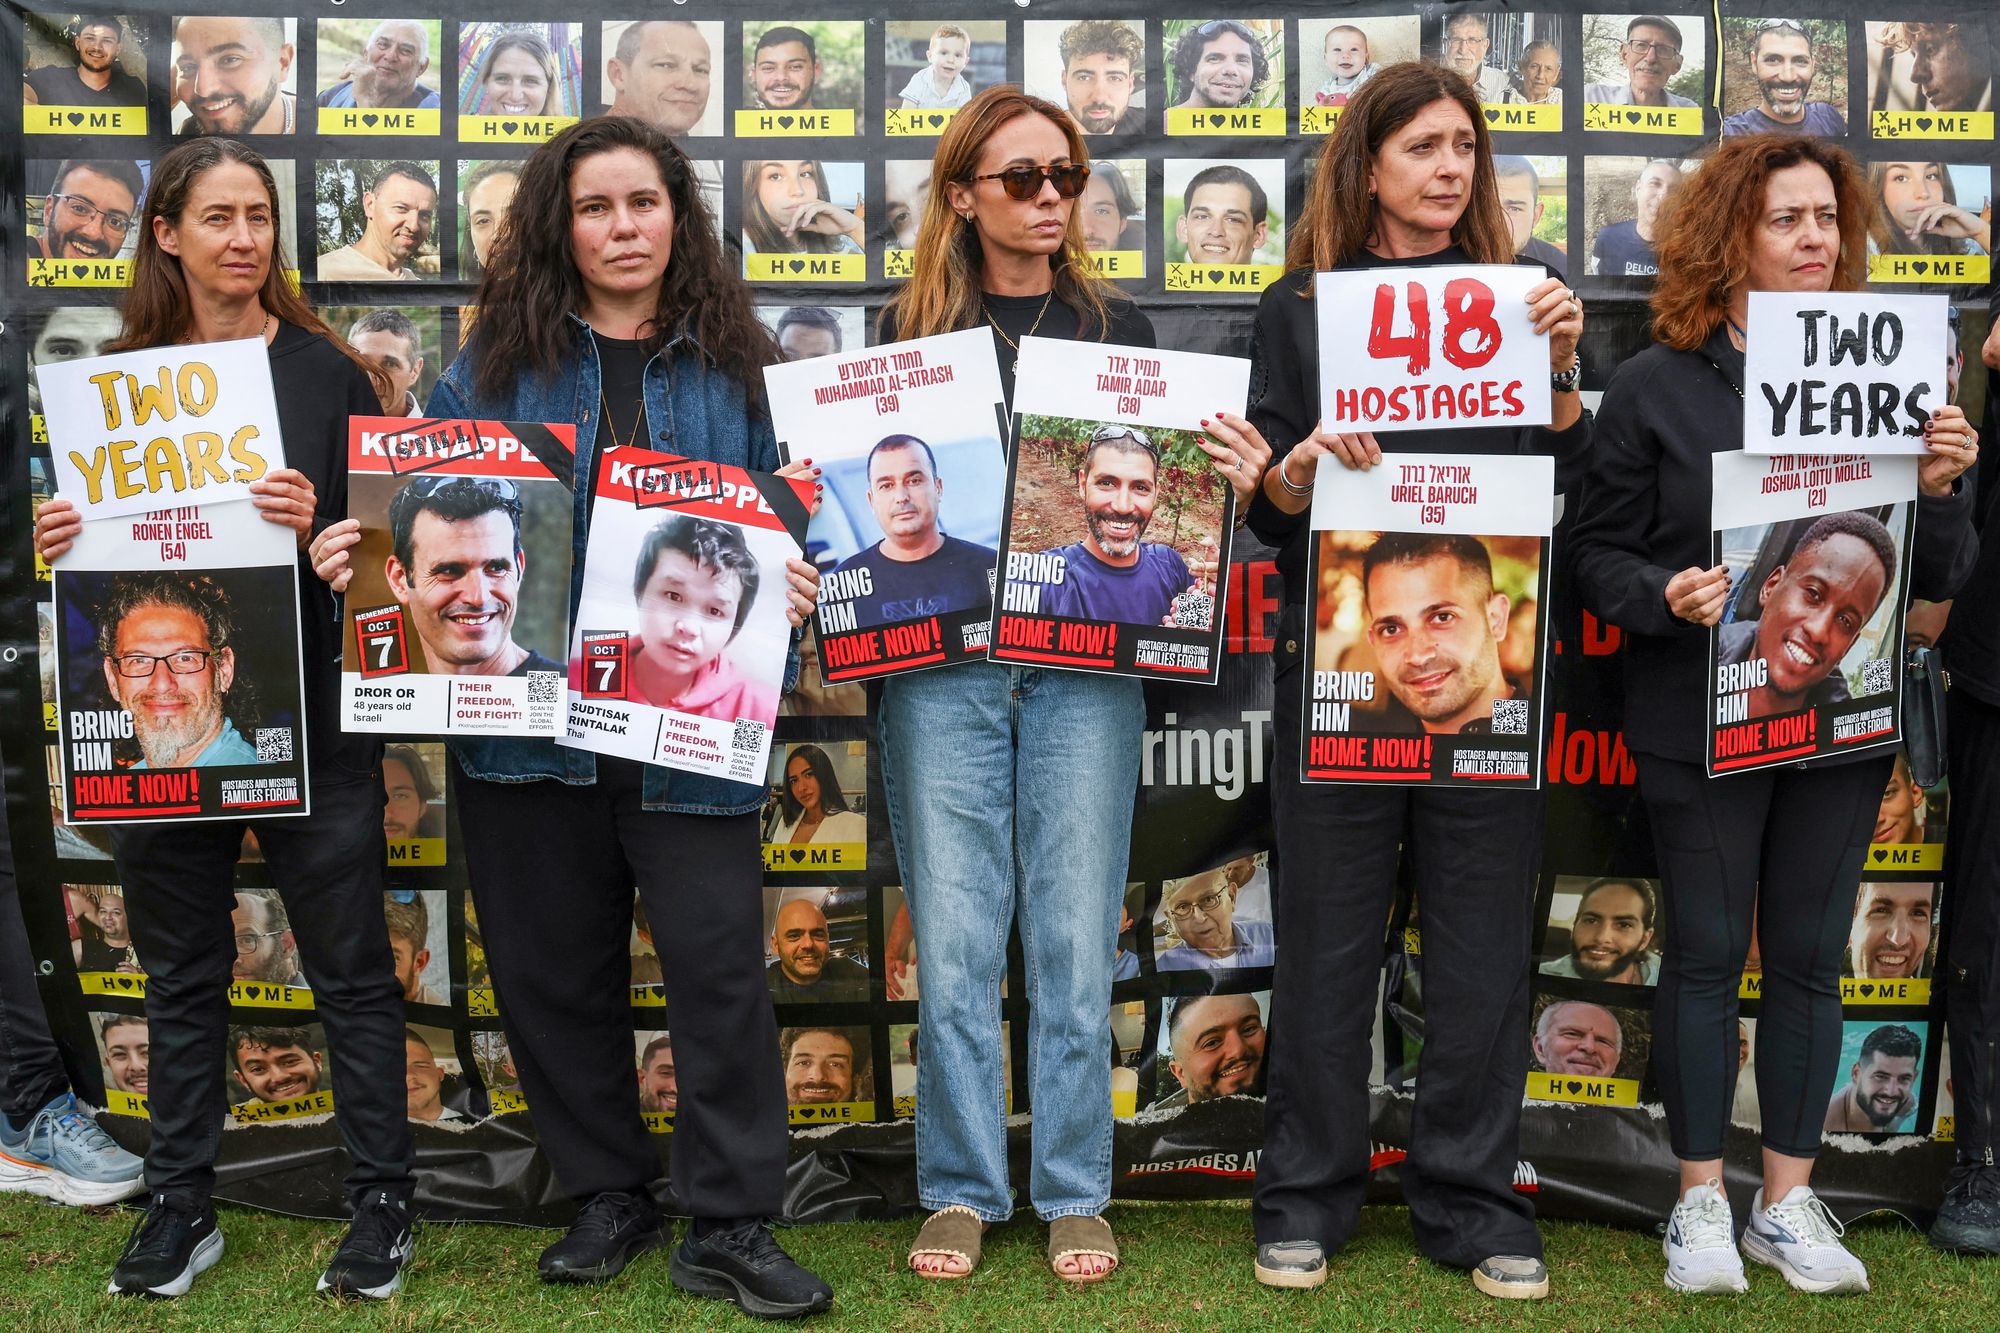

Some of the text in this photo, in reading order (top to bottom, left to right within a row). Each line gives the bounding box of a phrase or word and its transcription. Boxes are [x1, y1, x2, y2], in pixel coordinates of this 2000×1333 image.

[1367, 277, 1503, 376] 48
[1796, 309, 1904, 368] TWO
[1107, 355, 1161, 378] תמיר אדר
[88, 361, 219, 431] TWO
[814, 364, 954, 406] MUHAMMAD AL-ATRASH
[1096, 374, 1167, 398] TAMIR ADAR
[875, 392, 900, 417] (39)
[1117, 394, 1141, 417] (38)
[1335, 380, 1526, 423] HOSTAGES
[1760, 379, 1932, 440] YEARS
[395, 424, 472, 462] STILL
[68, 424, 269, 505] YEARS
[1399, 464, 1471, 485] אוריאל ברוך
[642, 467, 714, 496] STILL
[1760, 461, 1873, 495] JOSHUA LOITU MOLLEL
[1391, 485, 1477, 505] URIEL BARUCH
[1807, 486, 1827, 509] (21)
[1420, 504, 1446, 526] (35)
[132, 522, 213, 541] RONEN ENGEL
[160, 541, 186, 562] (54)
[1005, 551, 1067, 585] BRING
[817, 566, 874, 604] BRING
[1002, 582, 1041, 614] HIM
[355, 604, 401, 621] REMEMBER
[818, 600, 858, 635] HIM
[367, 620, 391, 633] OCT
[583, 631, 627, 643] REMEMBER
[999, 615, 1120, 657] HOME NOW!
[370, 635, 394, 668] 7
[593, 646, 616, 655] OCT
[823, 616, 943, 669] HOME NOW!
[963, 632, 990, 649] FAMIL
[1137, 639, 1210, 656] HOSTAGES AND MISSING
[1135, 650, 1209, 670] FAMILIES FORUM
[594, 660, 616, 691] 7
[1312, 670, 1375, 701] BRING
[1716, 657, 1769, 695] BRING
[354, 687, 416, 699] DROR OR
[457, 683, 493, 693] THEIR
[353, 701, 412, 712] 48 years old
[457, 696, 515, 708] FREEDOM,
[570, 702, 631, 723] SUDTISAK
[1716, 692, 1748, 726] HIM
[70, 709, 134, 741] BRING
[353, 713, 382, 723] Israeli
[456, 710, 523, 720] OUR FIGHT!
[568, 715, 627, 736] RINTALAK
[668, 718, 701, 732] THEIR
[1311, 702, 1350, 732] HIM
[1833, 706, 1893, 727] HOSTAGES AND MISSING
[566, 727, 586, 739] Thai
[1715, 708, 1817, 759] HOME NOW!
[1833, 716, 1893, 740] FAMILIES FORUM
[665, 731, 720, 751] FREEDOM,
[1309, 735, 1433, 769] HOME NOW!
[72, 742, 113, 771] HIM
[663, 744, 725, 764] OUR FIGHT!
[731, 758, 744, 766] JOIN
[732, 752, 748, 760] SCAN
[1453, 749, 1528, 762] HOSTAGES AND MISSING
[728, 770, 753, 780] EFFORTS
[730, 765, 753, 773] GLOBAL
[1453, 759, 1528, 776] FAMILIES FORUM
[74, 768, 200, 806] HOME NOW!
[221, 777, 297, 791] HOSTAGES AND MISSING
[221, 786, 298, 804] FAMILIES FORUM
[1130, 1152, 1239, 1174] HOSTAGES
